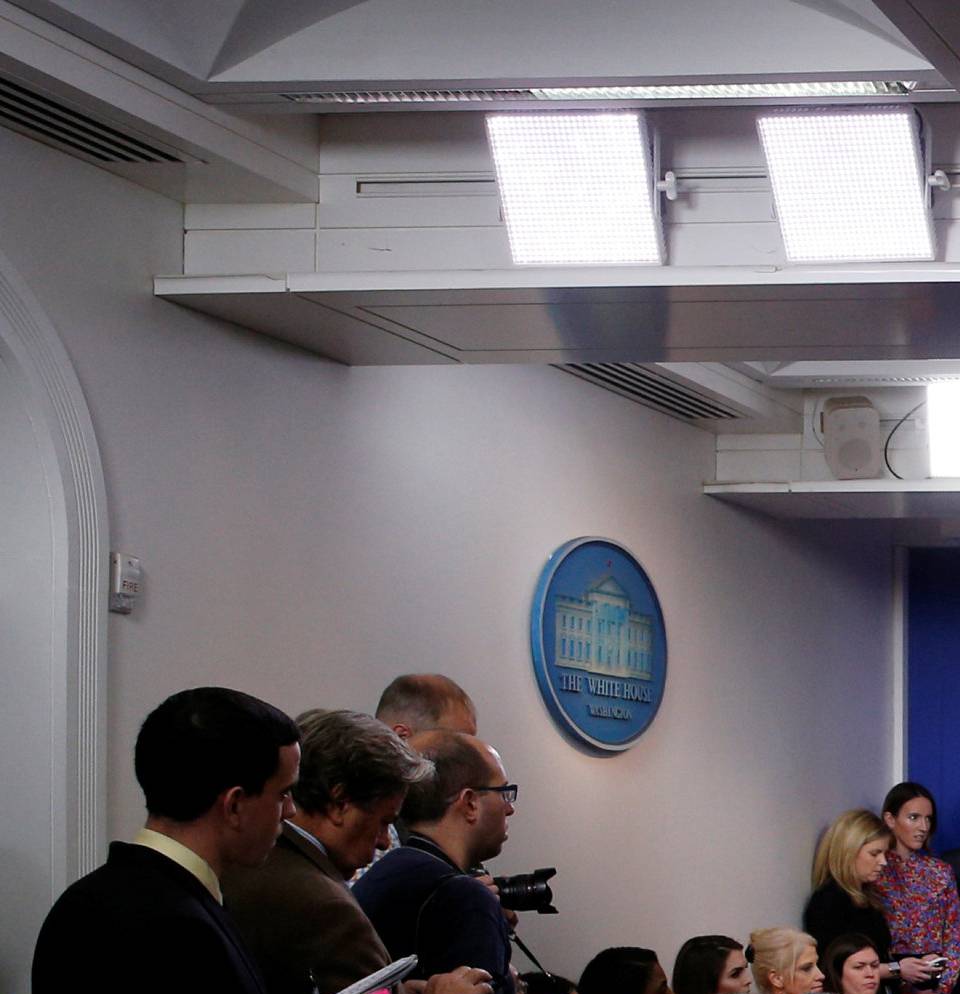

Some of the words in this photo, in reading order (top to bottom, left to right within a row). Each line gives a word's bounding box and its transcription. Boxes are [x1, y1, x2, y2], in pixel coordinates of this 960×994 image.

[561, 673, 582, 691] THE
[587, 677, 621, 697] WHITE
[624, 682, 652, 702] HOUSE
